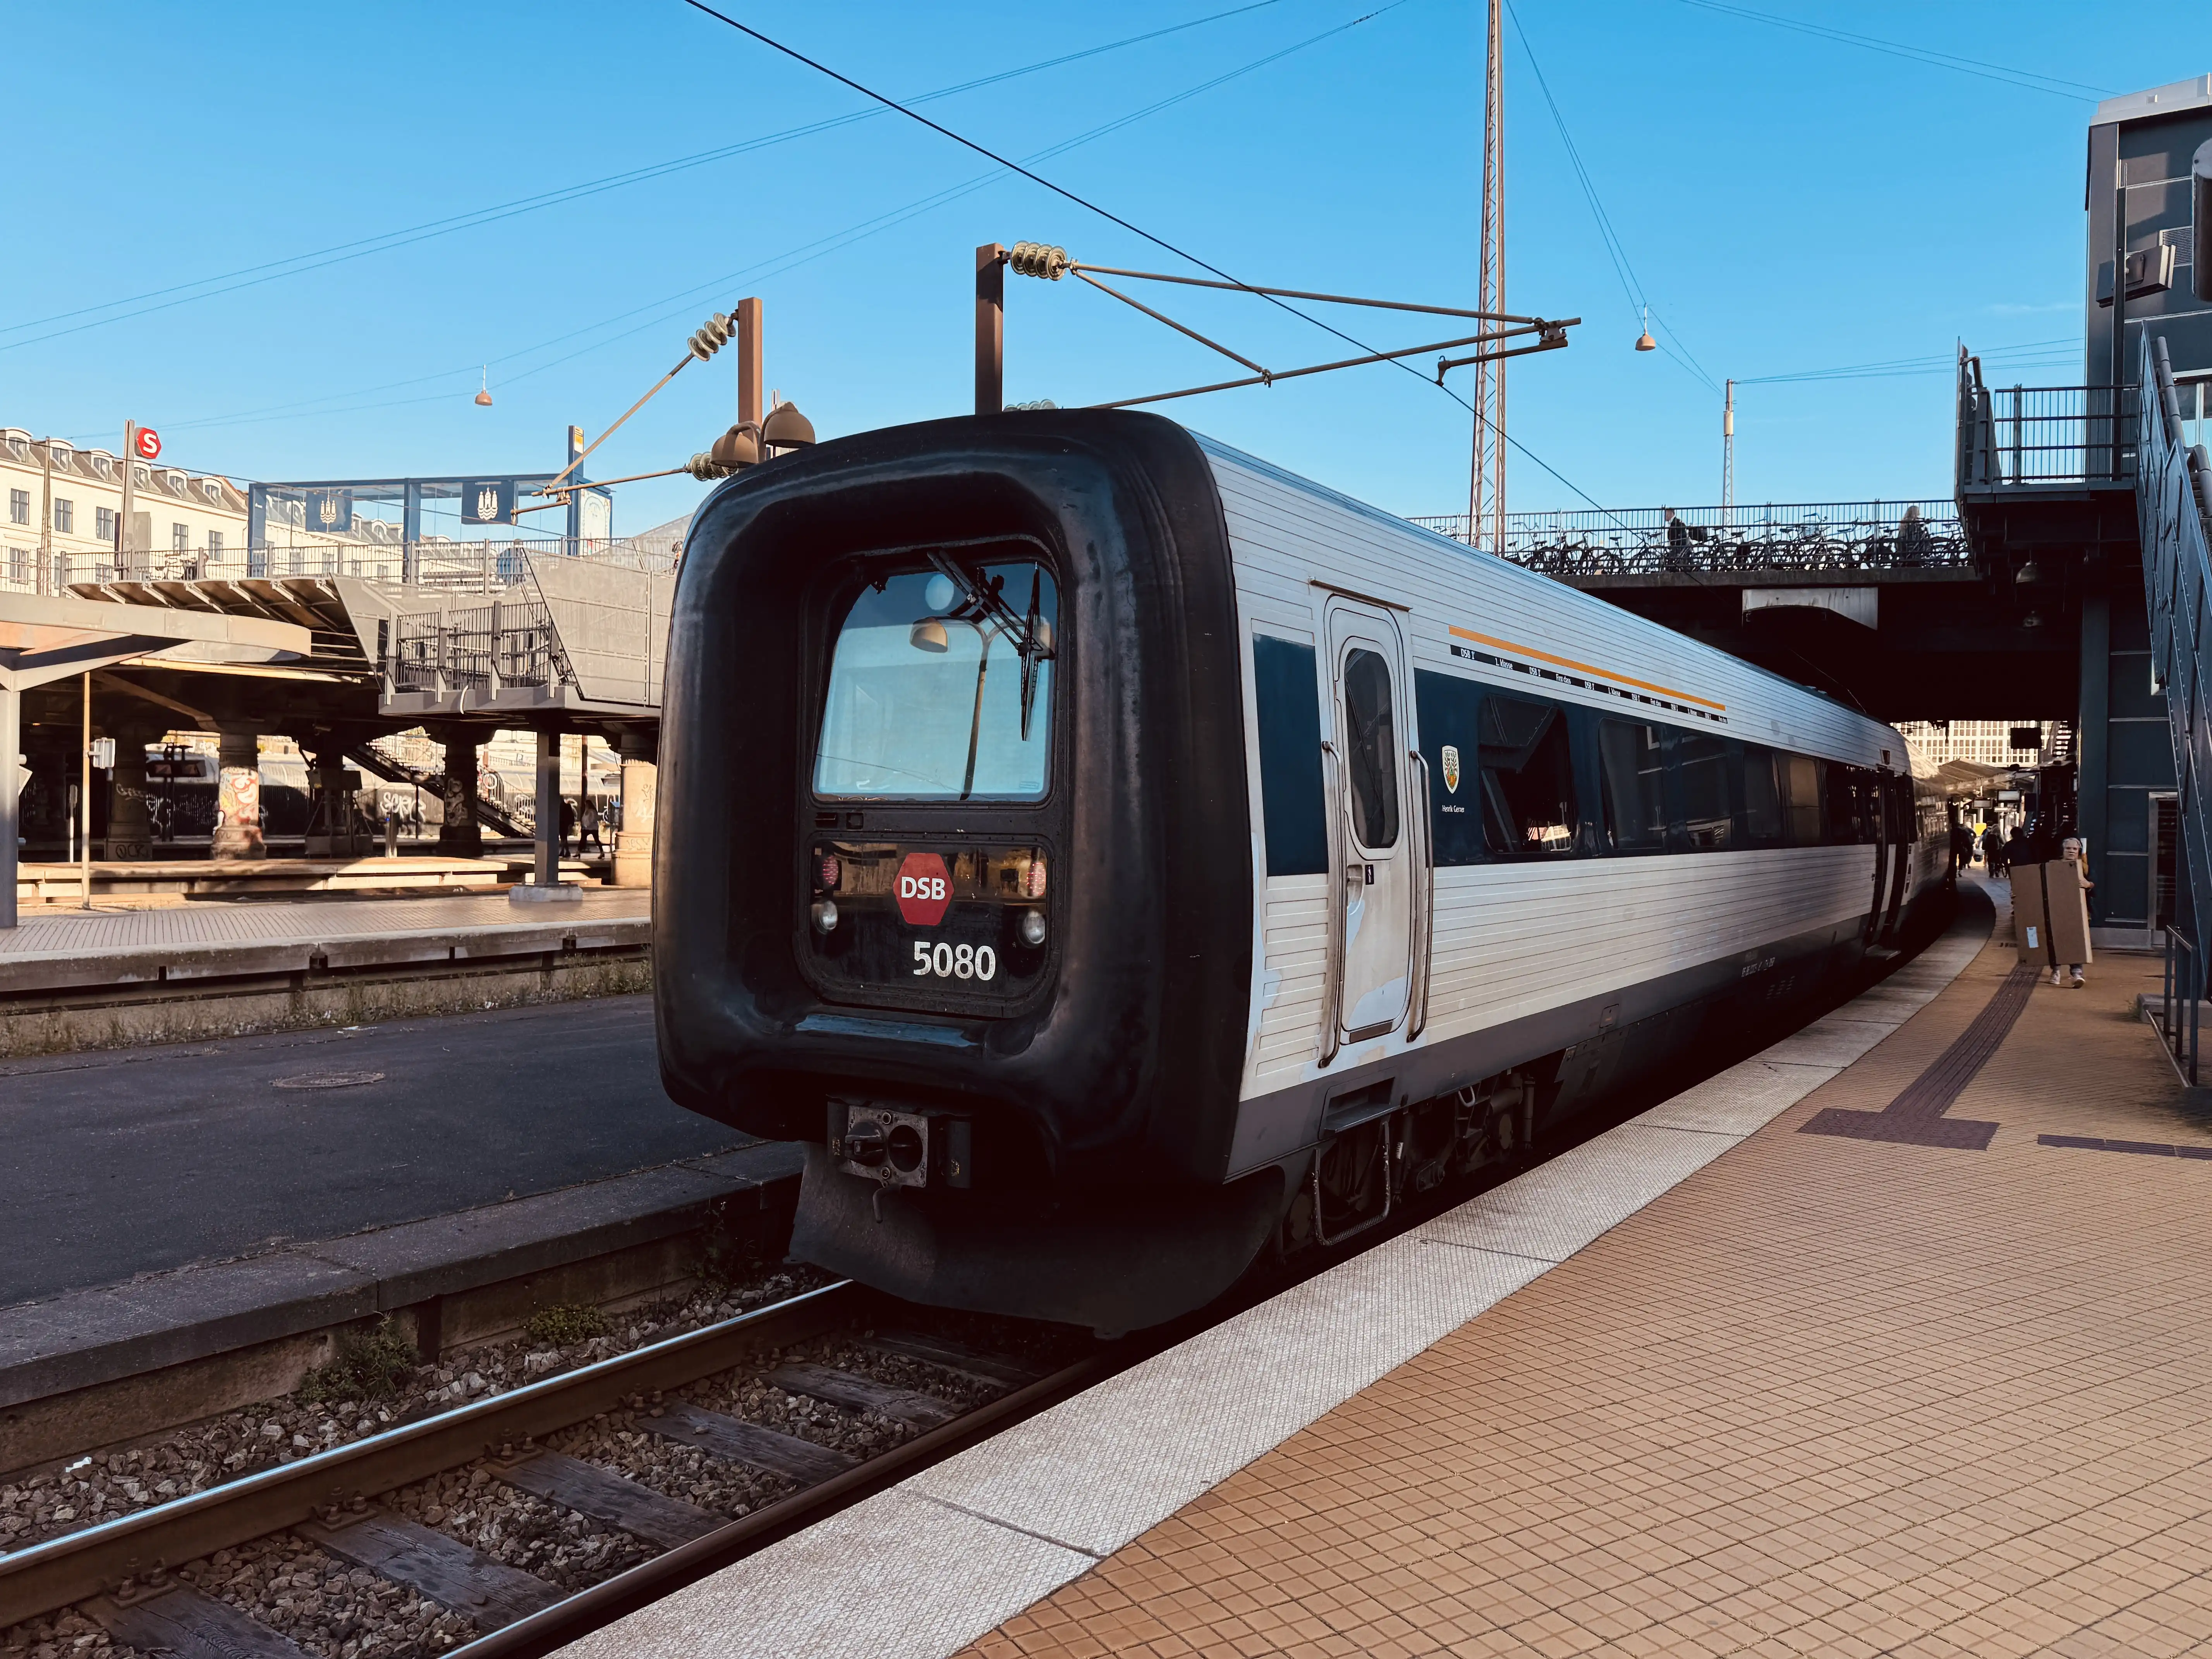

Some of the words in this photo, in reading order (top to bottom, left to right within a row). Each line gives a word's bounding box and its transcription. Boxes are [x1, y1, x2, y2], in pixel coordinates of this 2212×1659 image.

[143, 433, 157, 453] S
[1460, 648, 1470, 658] DSB
[901, 876, 946, 900] DSB
[913, 941, 996, 981] 5080
